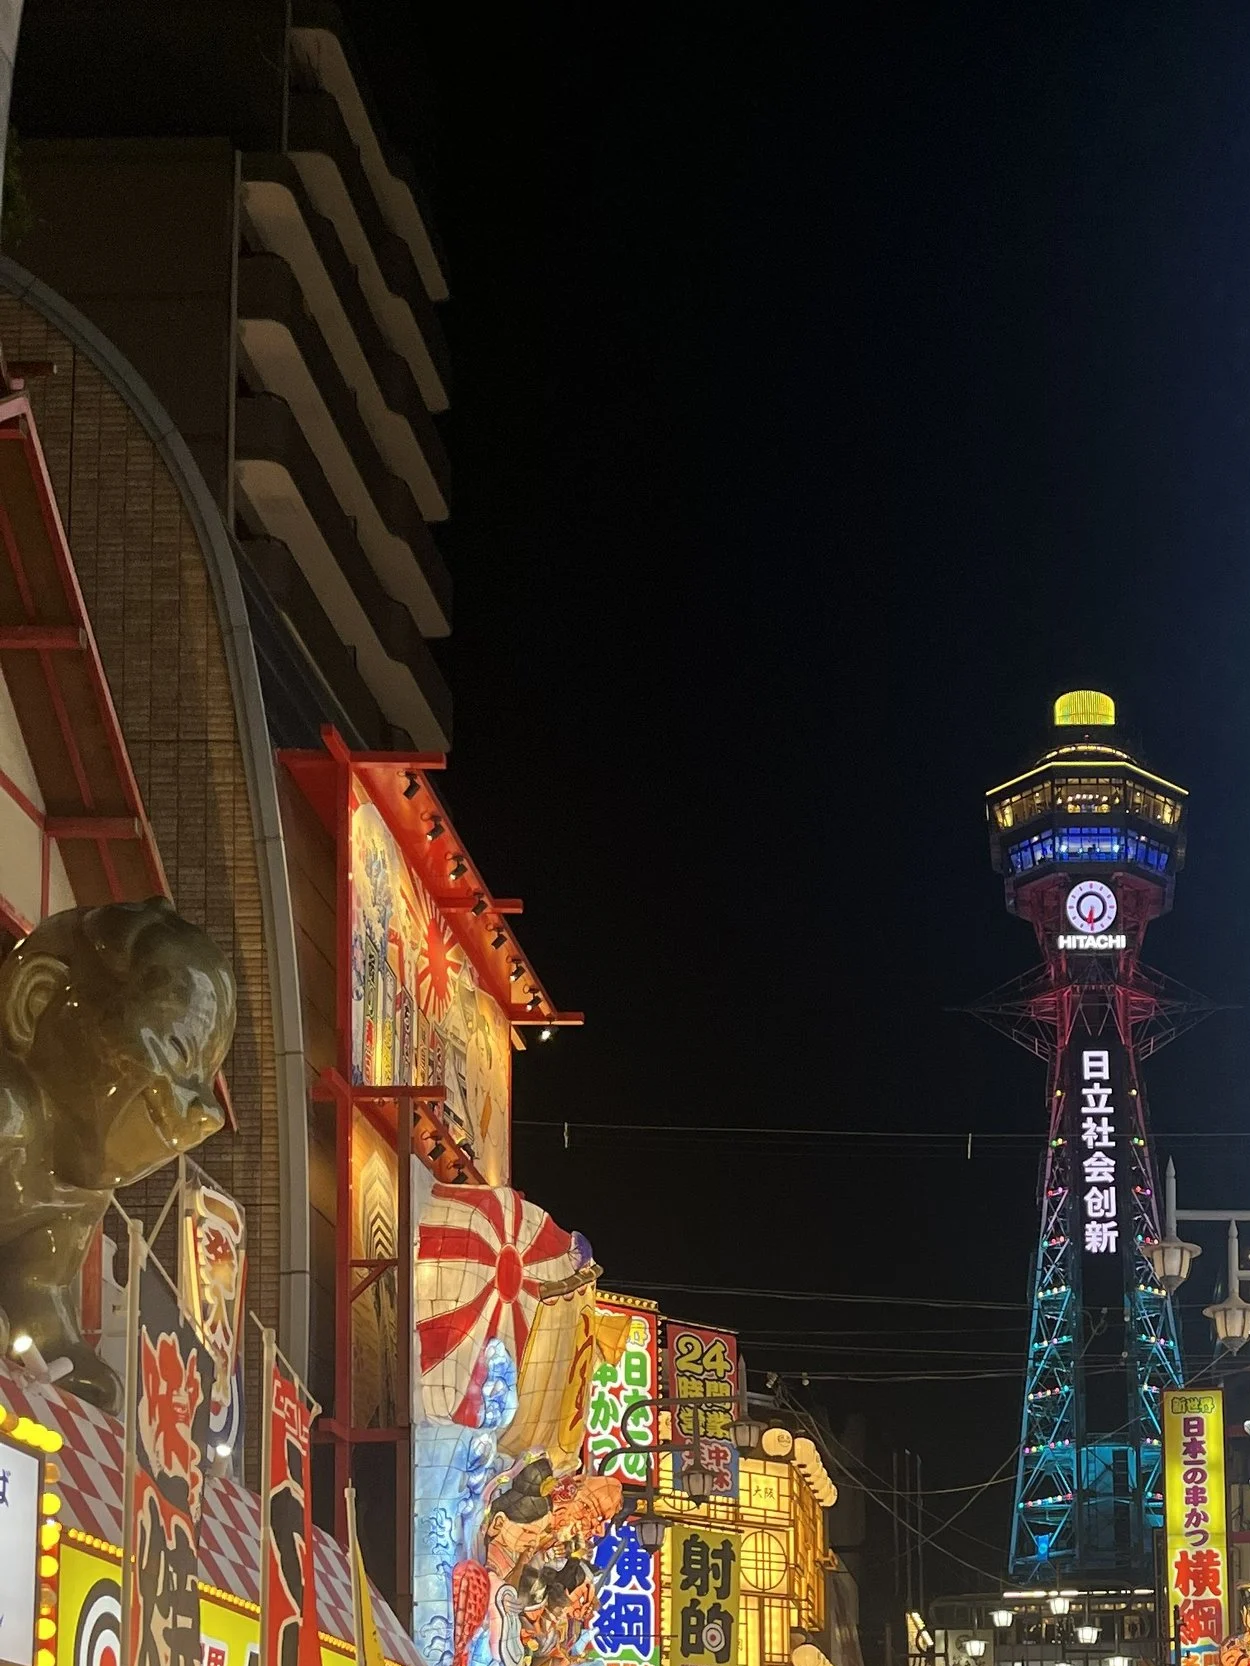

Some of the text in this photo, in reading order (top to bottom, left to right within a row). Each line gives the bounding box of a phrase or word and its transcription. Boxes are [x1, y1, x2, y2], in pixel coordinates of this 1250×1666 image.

[1058, 934, 1127, 949] HITACHI
[1081, 1050, 1119, 1253] 日立社会创新
[674, 1333, 734, 1381] 24
[1171, 1396, 1216, 1415] 新世界
[752, 1483, 777, 1502] 大阪
[1182, 1416, 1210, 1547] 日本一の串かつ
[594, 1520, 654, 1661] 横綱
[680, 1533, 736, 1666] 射的
[1174, 1549, 1223, 1645] 横綱
